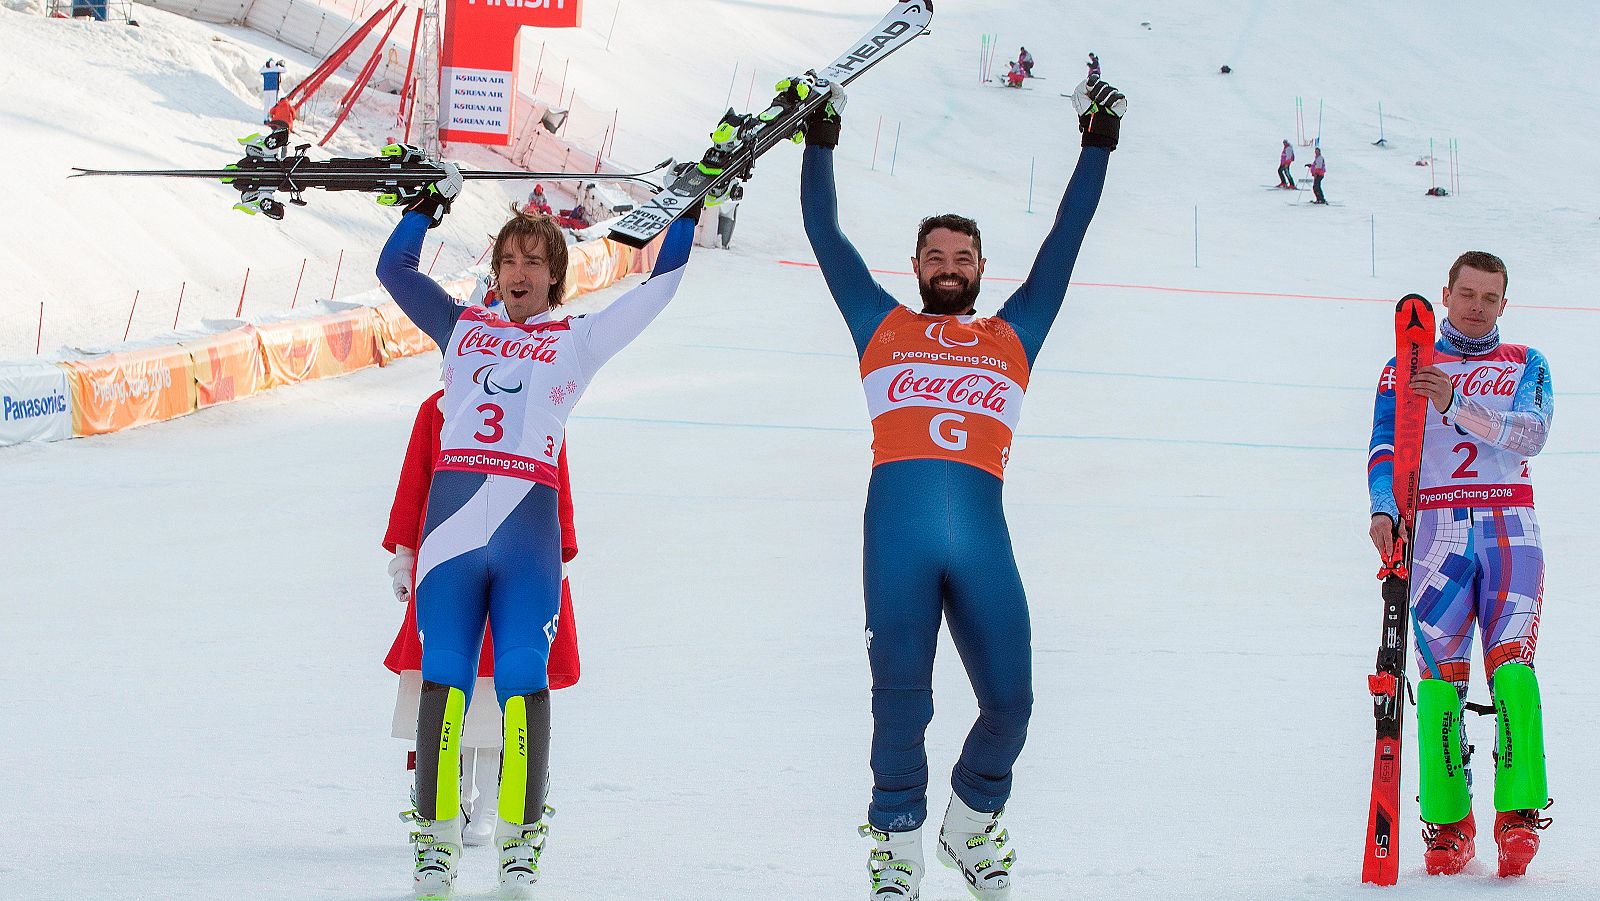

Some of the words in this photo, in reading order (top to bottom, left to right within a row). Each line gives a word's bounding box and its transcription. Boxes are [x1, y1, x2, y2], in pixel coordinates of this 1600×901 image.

[836, 21, 911, 71] HEAD
[454, 89, 487, 97] KOREAN
[455, 75, 488, 83] KOREAN
[453, 103, 486, 111] KOREAN
[453, 117, 485, 125] KOREAN
[621, 214, 664, 230] CUP
[633, 210, 670, 225] WORLD
[457, 326, 560, 363] CocaCola
[892, 351, 980, 365] PyeongChang
[981, 355, 1009, 371] 2018
[1410, 341, 1420, 383] ATOM
[1537, 366, 1545, 386] DON
[887, 368, 1011, 414] Coca-Cola
[1450, 366, 1518, 397] a-Cola
[3, 388, 67, 421] Panasonic
[473, 402, 505, 444] 3
[928, 412, 968, 451] G
[443, 454, 513, 469] PyeongChang
[512, 459, 535, 473] 2018
[1451, 441, 1479, 479] 2
[1406, 471, 1415, 509] REDSTER
[1420, 489, 1489, 503] PyeongChang
[1490, 488, 1513, 498] 2018
[442, 721, 451, 751] LEKI
[1442, 710, 1454, 777] KOMPERDELL
[1375, 834, 1388, 858] S9
